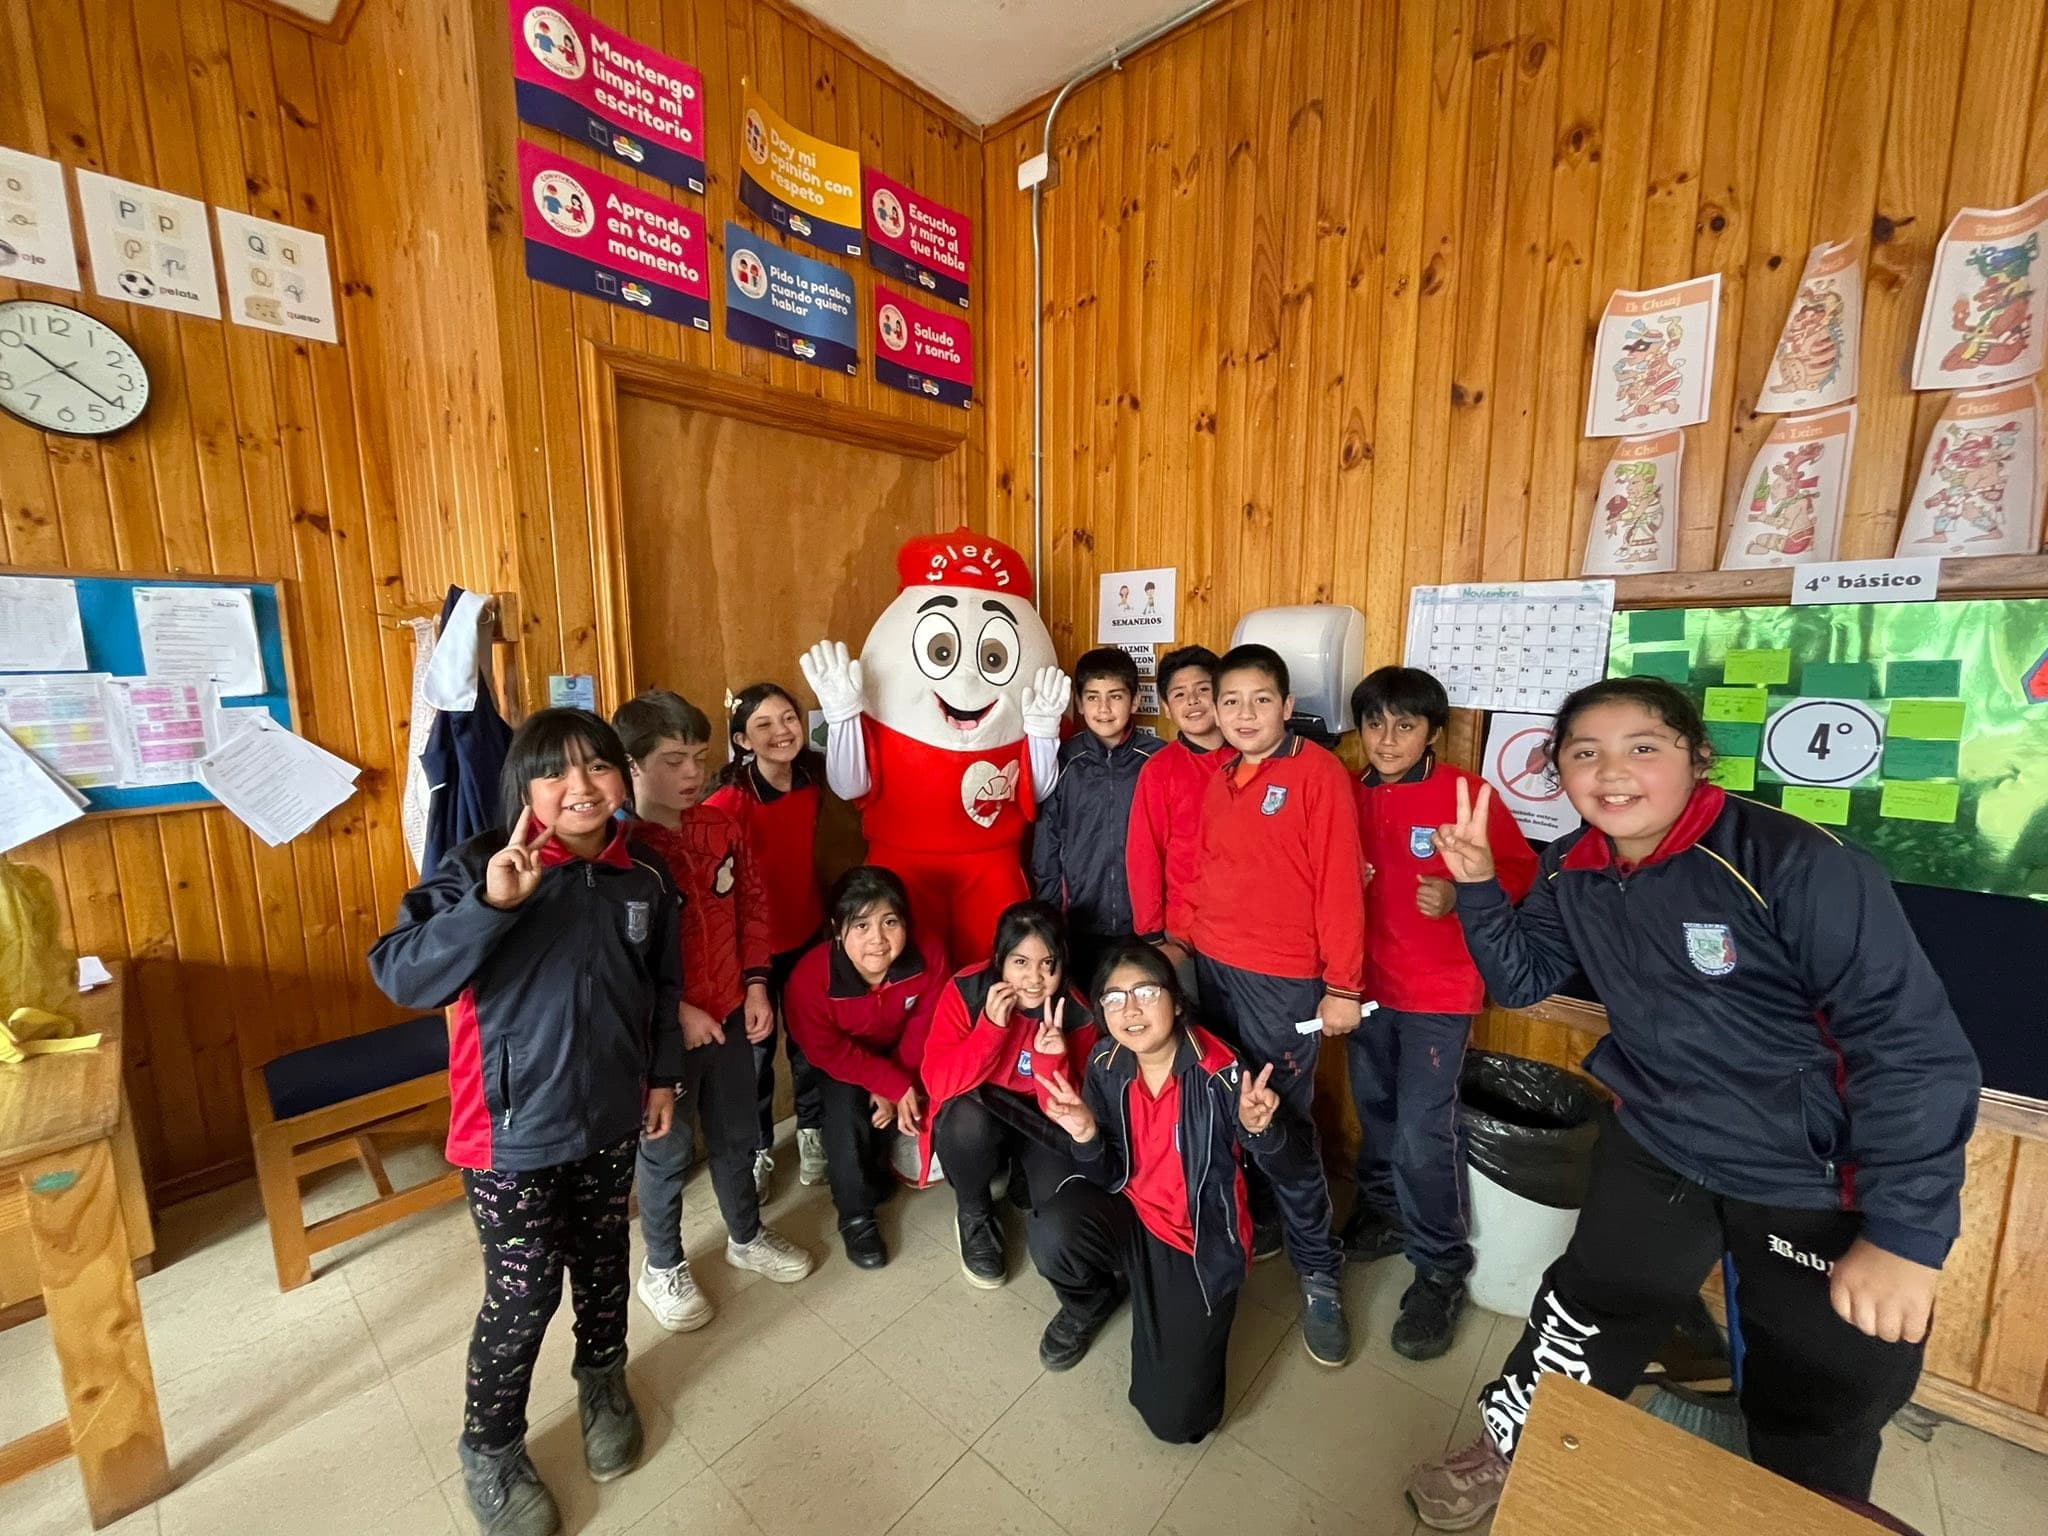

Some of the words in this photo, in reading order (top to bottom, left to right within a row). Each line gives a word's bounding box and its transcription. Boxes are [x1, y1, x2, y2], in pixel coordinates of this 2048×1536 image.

[590, 33, 695, 99] Mantengo
[592, 57, 654, 104] limpio
[659, 96, 683, 118] mi
[595, 88, 692, 143] escritorio
[770, 128, 795, 160] Doy
[798, 151, 816, 169] mi
[770, 152, 821, 187] opinión
[824, 179, 853, 198] con
[770, 169, 825, 205] respeto
[119, 200, 137, 219] P
[606, 192, 691, 239] Aprendo
[908, 203, 957, 237] Escucho
[248, 235, 267, 255] Q
[607, 217, 633, 238] en
[637, 225, 683, 256] todo
[909, 222, 917, 237] y
[920, 227, 945, 248] miro
[947, 239, 959, 254] al
[608, 238, 699, 282] momento
[909, 239, 931, 256] que
[933, 246, 965, 272] habla
[159, 286, 200, 301] pelota
[770, 265, 794, 284] Pido
[796, 275, 809, 290] la
[810, 282, 852, 305] palabra
[771, 283, 812, 304] cuando
[814, 297, 849, 316] quiero
[771, 294, 809, 317] hablar
[19, 314, 36, 335] 11
[47, 315, 71, 338] 12
[286, 311, 321, 324] queso
[88, 329, 94, 348] 1
[913, 322, 954, 347] Saludo
[106, 350, 124, 369] 2
[914, 340, 923, 356] y
[924, 344, 961, 364] sonrío
[117, 373, 135, 392] 3
[24, 392, 42, 410] 7
[111, 395, 125, 411] 4
[57, 406, 75, 423] 6
[88, 403, 105, 423] 5
[1462, 586, 1520, 599] Noviembre
[1837, 573, 1922, 589] básico
[1111, 616, 1162, 627] SEMANEROS
[1807, 722, 1853, 760] 4°
